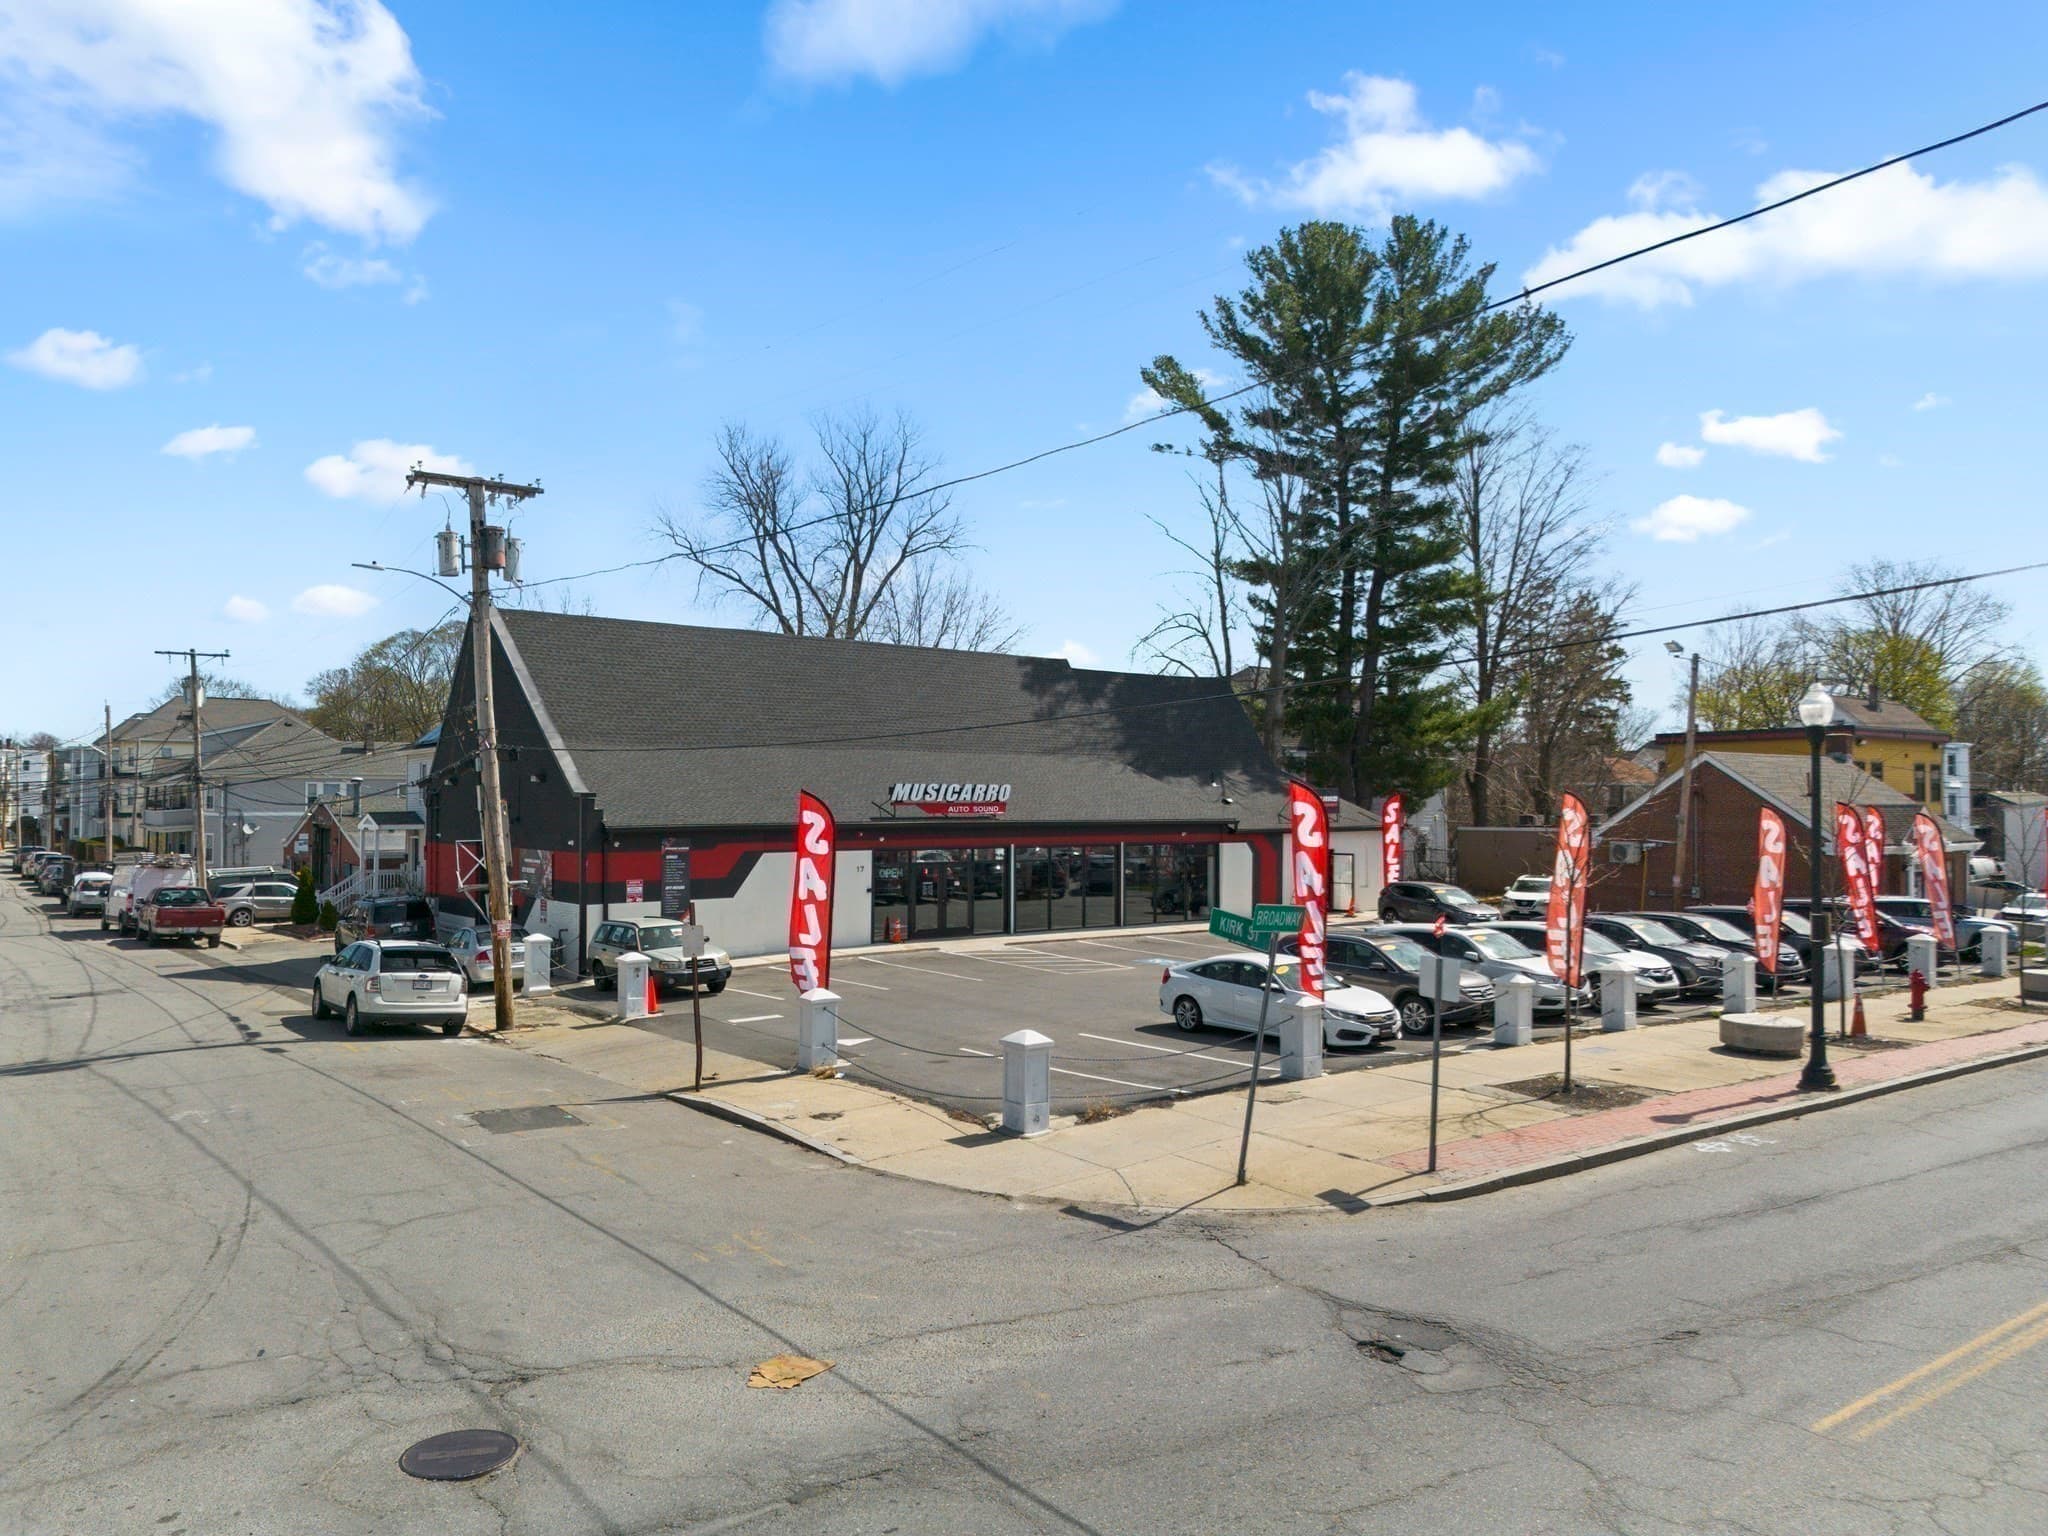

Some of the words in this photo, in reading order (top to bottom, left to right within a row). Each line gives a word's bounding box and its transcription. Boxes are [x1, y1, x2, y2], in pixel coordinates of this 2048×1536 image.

[891, 783, 1012, 802] MUSICARRO
[1384, 801, 1400, 883] SALE
[879, 868, 903, 878] OPEN
[1256, 910, 1303, 927] BROADWAY
[1219, 916, 1245, 937] KIRK
[1247, 925, 1260, 942] ST
